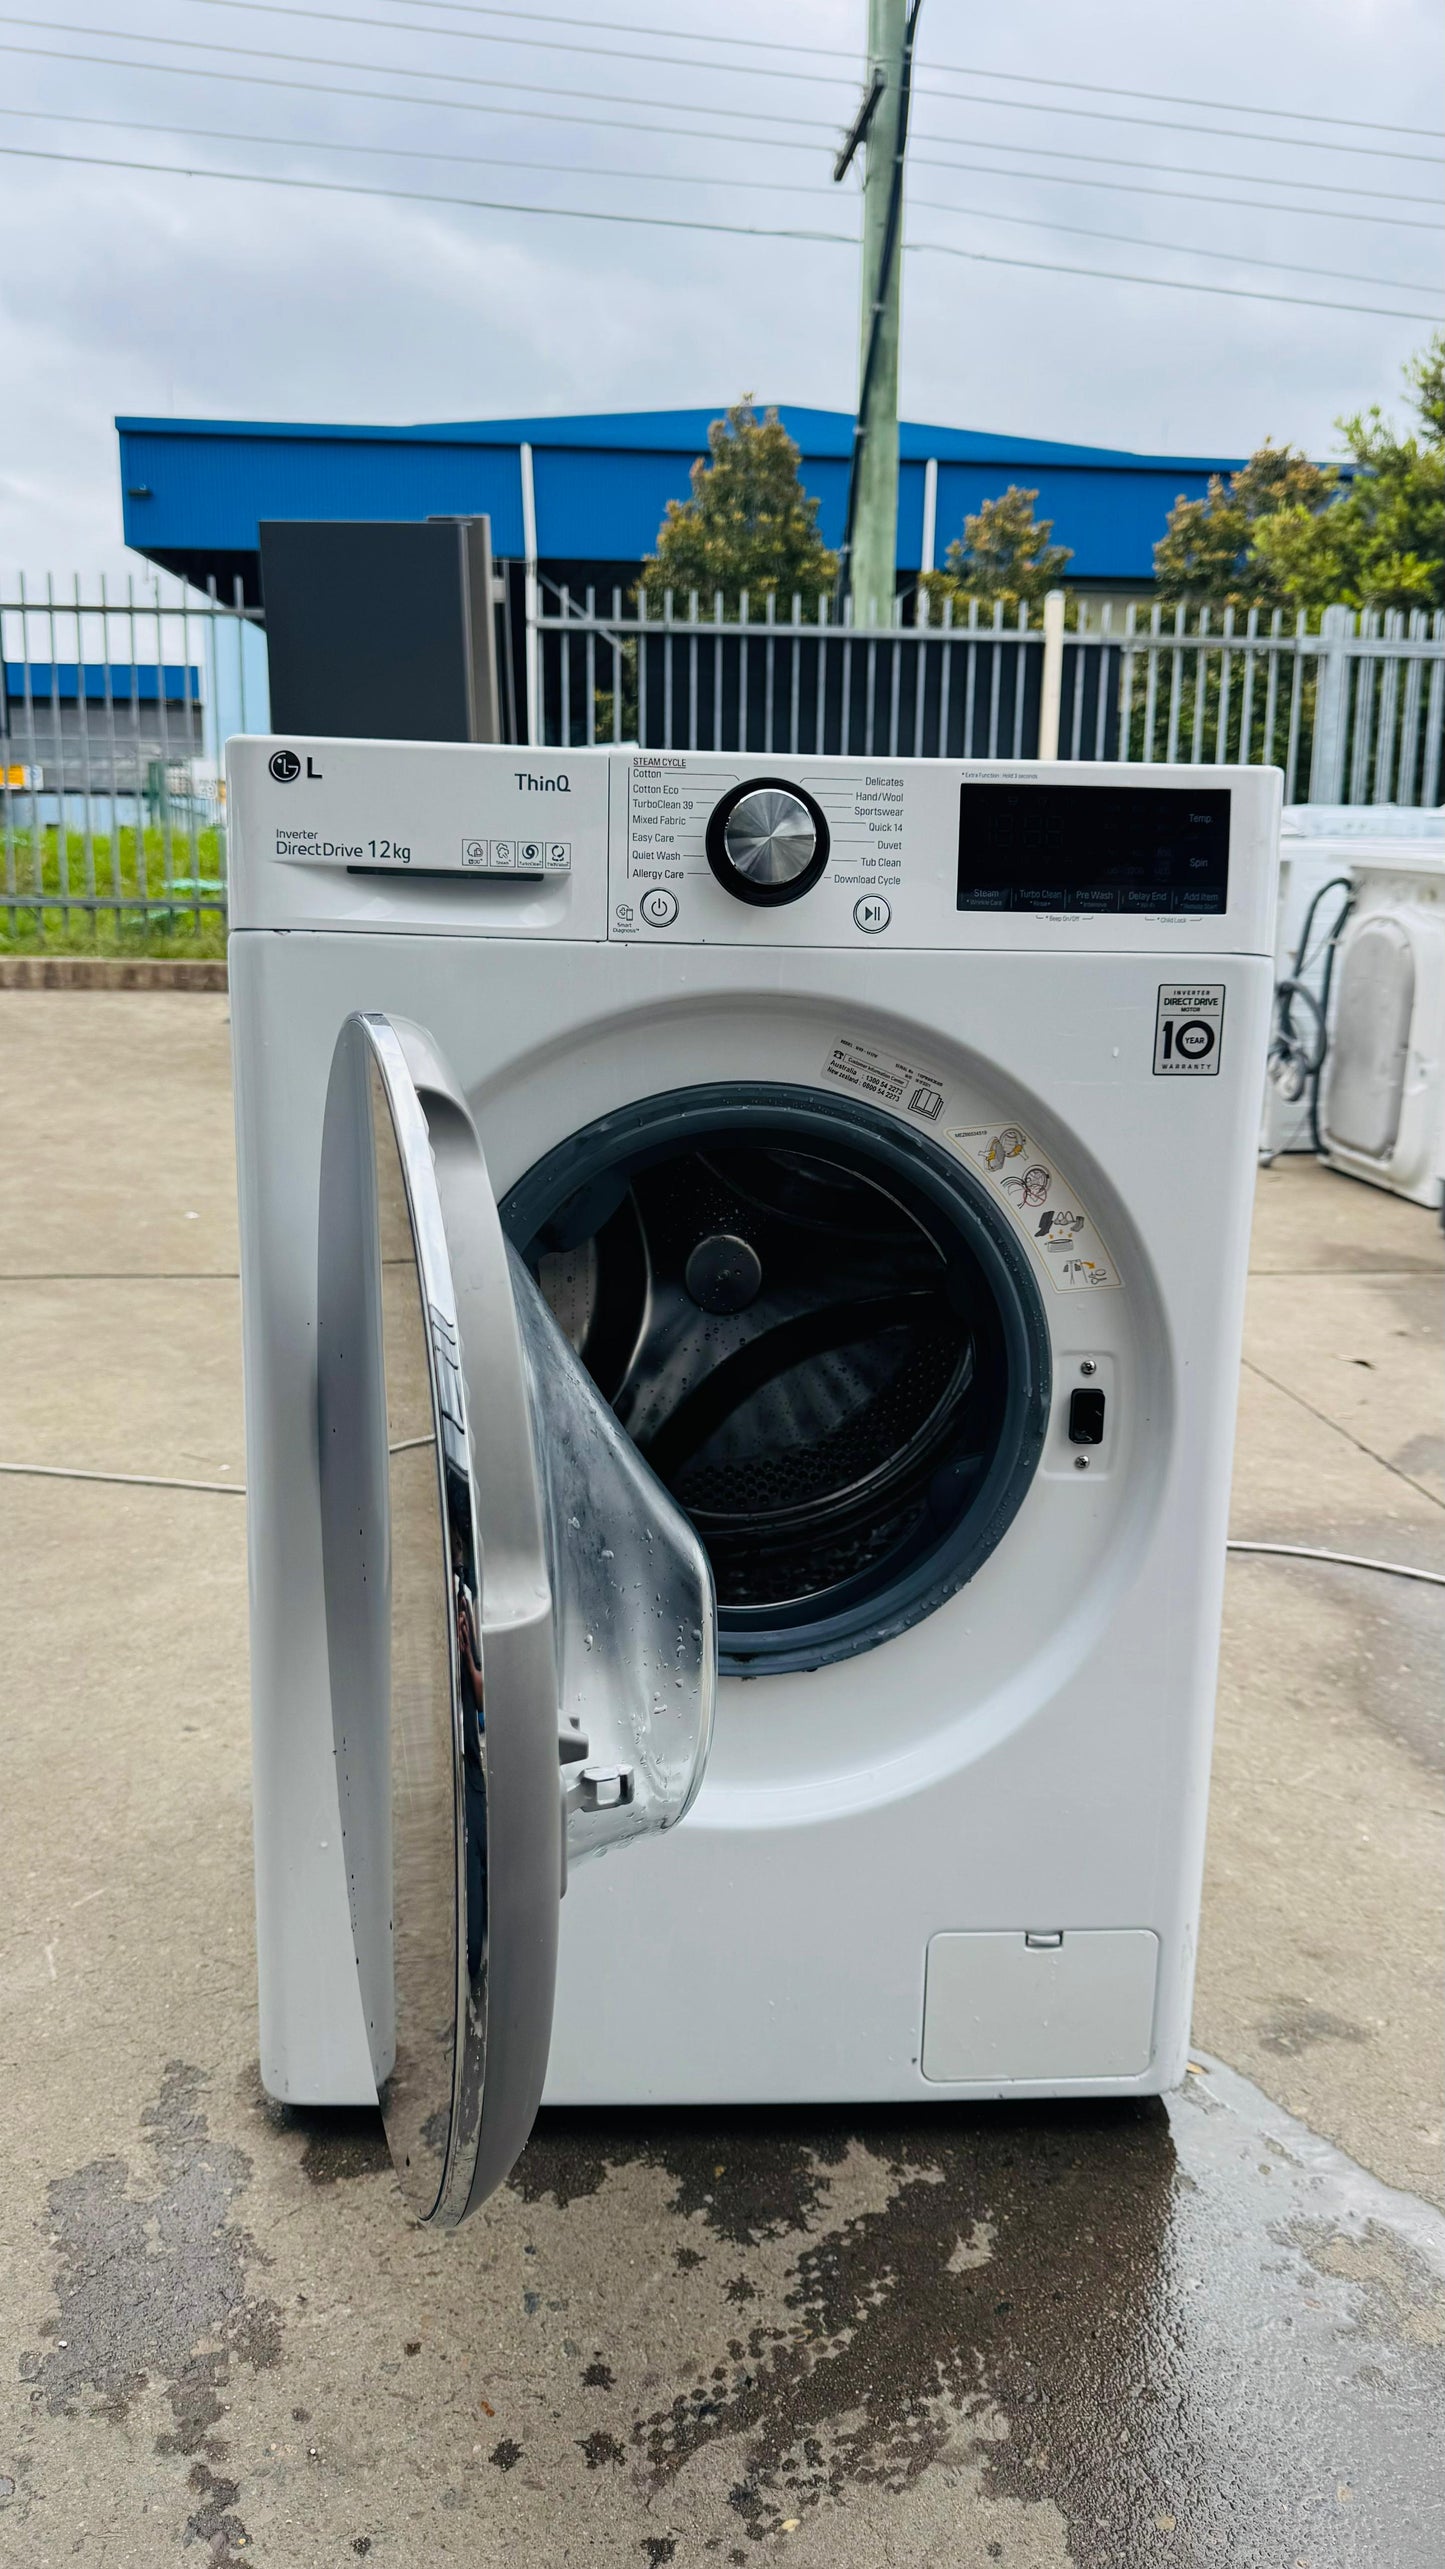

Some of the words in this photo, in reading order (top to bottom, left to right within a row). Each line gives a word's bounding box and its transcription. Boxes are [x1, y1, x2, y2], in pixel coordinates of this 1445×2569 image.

[633, 757, 661, 766] STEAM
[662, 758, 686, 767] CYCLE
[633, 769, 661, 778] Cotton
[515, 773, 571, 793] ThinQ
[866, 777, 904, 787] Delicates
[633, 784, 661, 794] Cotton
[663, 785, 679, 795] Eco
[856, 792, 903, 802] Hand/Wool
[633, 799, 681, 809] TurboClean
[683, 800, 693, 810] 39
[854, 807, 904, 817] Sportswear
[632, 815, 657, 825] Mixed
[659, 816, 686, 826] Fabric
[1189, 813, 1213, 825] Temp.
[869, 823, 891, 832] Quick
[893, 823, 903, 832] 14
[276, 828, 318, 840] Inverter
[632, 833, 650, 844] Easy
[652, 833, 675, 843] Care
[877, 840, 902, 850] Duvet
[632, 851, 654, 861] Quiet
[656, 851, 681, 861] Wash
[861, 857, 876, 867] Tub
[878, 857, 901, 867] Clean
[1189, 858, 1208, 869] Spin
[632, 869, 660, 880] Allergy
[662, 869, 684, 879] Care
[834, 874, 874, 884] Download
[876, 875, 901, 886] Cycle
[974, 888, 999, 898] Steam
[1020, 889, 1041, 899] Turbo
[1042, 889, 1062, 900] Clean
[1076, 890, 1089, 900] Pre
[1090, 891, 1113, 901] Wash
[1128, 891, 1149, 902] Delay
[1151, 891, 1167, 901] End
[1183, 892, 1202, 902] Add
[1203, 893, 1219, 902] Item
[1164, 998, 1193, 1006] DIRECT
[1194, 998, 1219, 1006] DRIVE
[1162, 1020, 1215, 1060] 10
[830, 1059, 857, 1076] Australia
[866, 1074, 880, 1085] 1300
[879, 1082, 888, 1090] 54
[889, 1084, 904, 1096] 2273
[827, 1066, 839, 1076] New
[877, 1087, 885, 1096] 54
[885, 1092, 900, 1103] 2273
